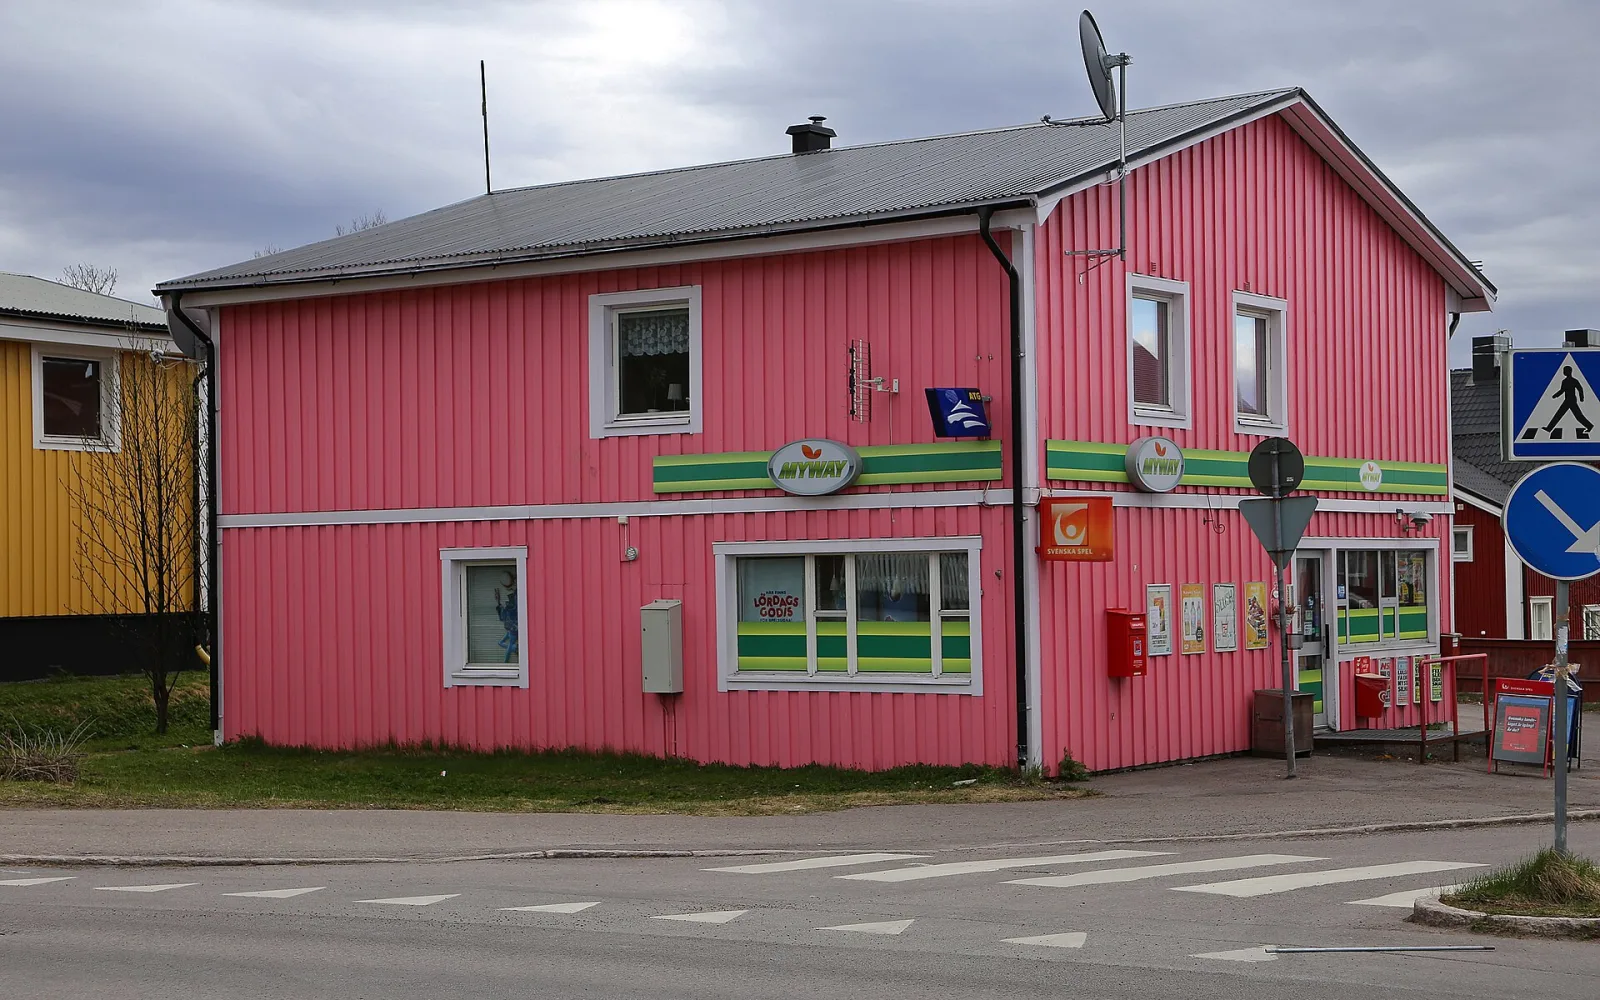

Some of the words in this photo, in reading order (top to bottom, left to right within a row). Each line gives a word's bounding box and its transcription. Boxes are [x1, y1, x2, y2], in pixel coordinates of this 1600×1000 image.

[968, 391, 981, 401] ATG
[778, 459, 848, 479] MYWAY
[1142, 457, 1181, 476] MYWAY
[754, 593, 799, 607] LÖRDAGS
[760, 607, 793, 617] GODIS
